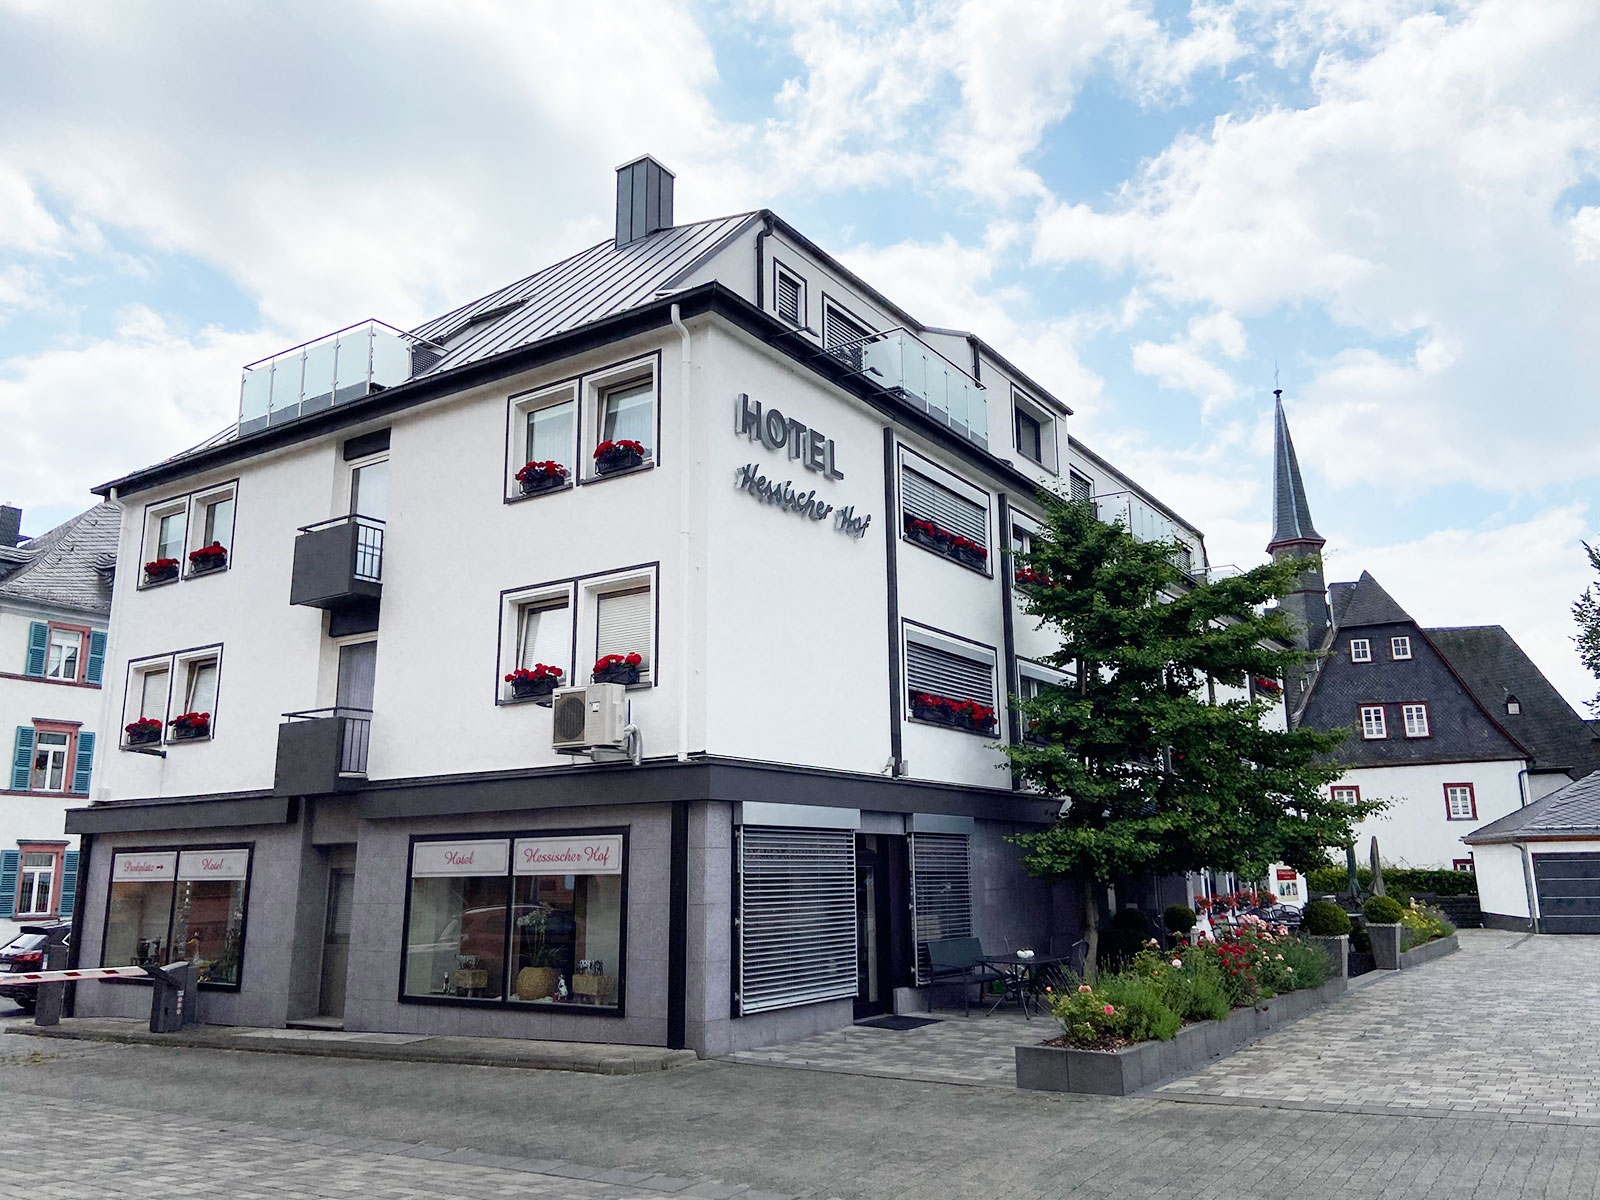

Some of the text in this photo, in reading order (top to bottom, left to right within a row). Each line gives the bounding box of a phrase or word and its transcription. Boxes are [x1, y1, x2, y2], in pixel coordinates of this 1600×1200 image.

[735, 393, 844, 481] HOTEL
[735, 463, 872, 539] Hessischer Hof
[202, 858, 224, 871] Hotel
[444, 850, 474, 865] Hotel
[524, 846, 610, 866] Hessischer Hof
